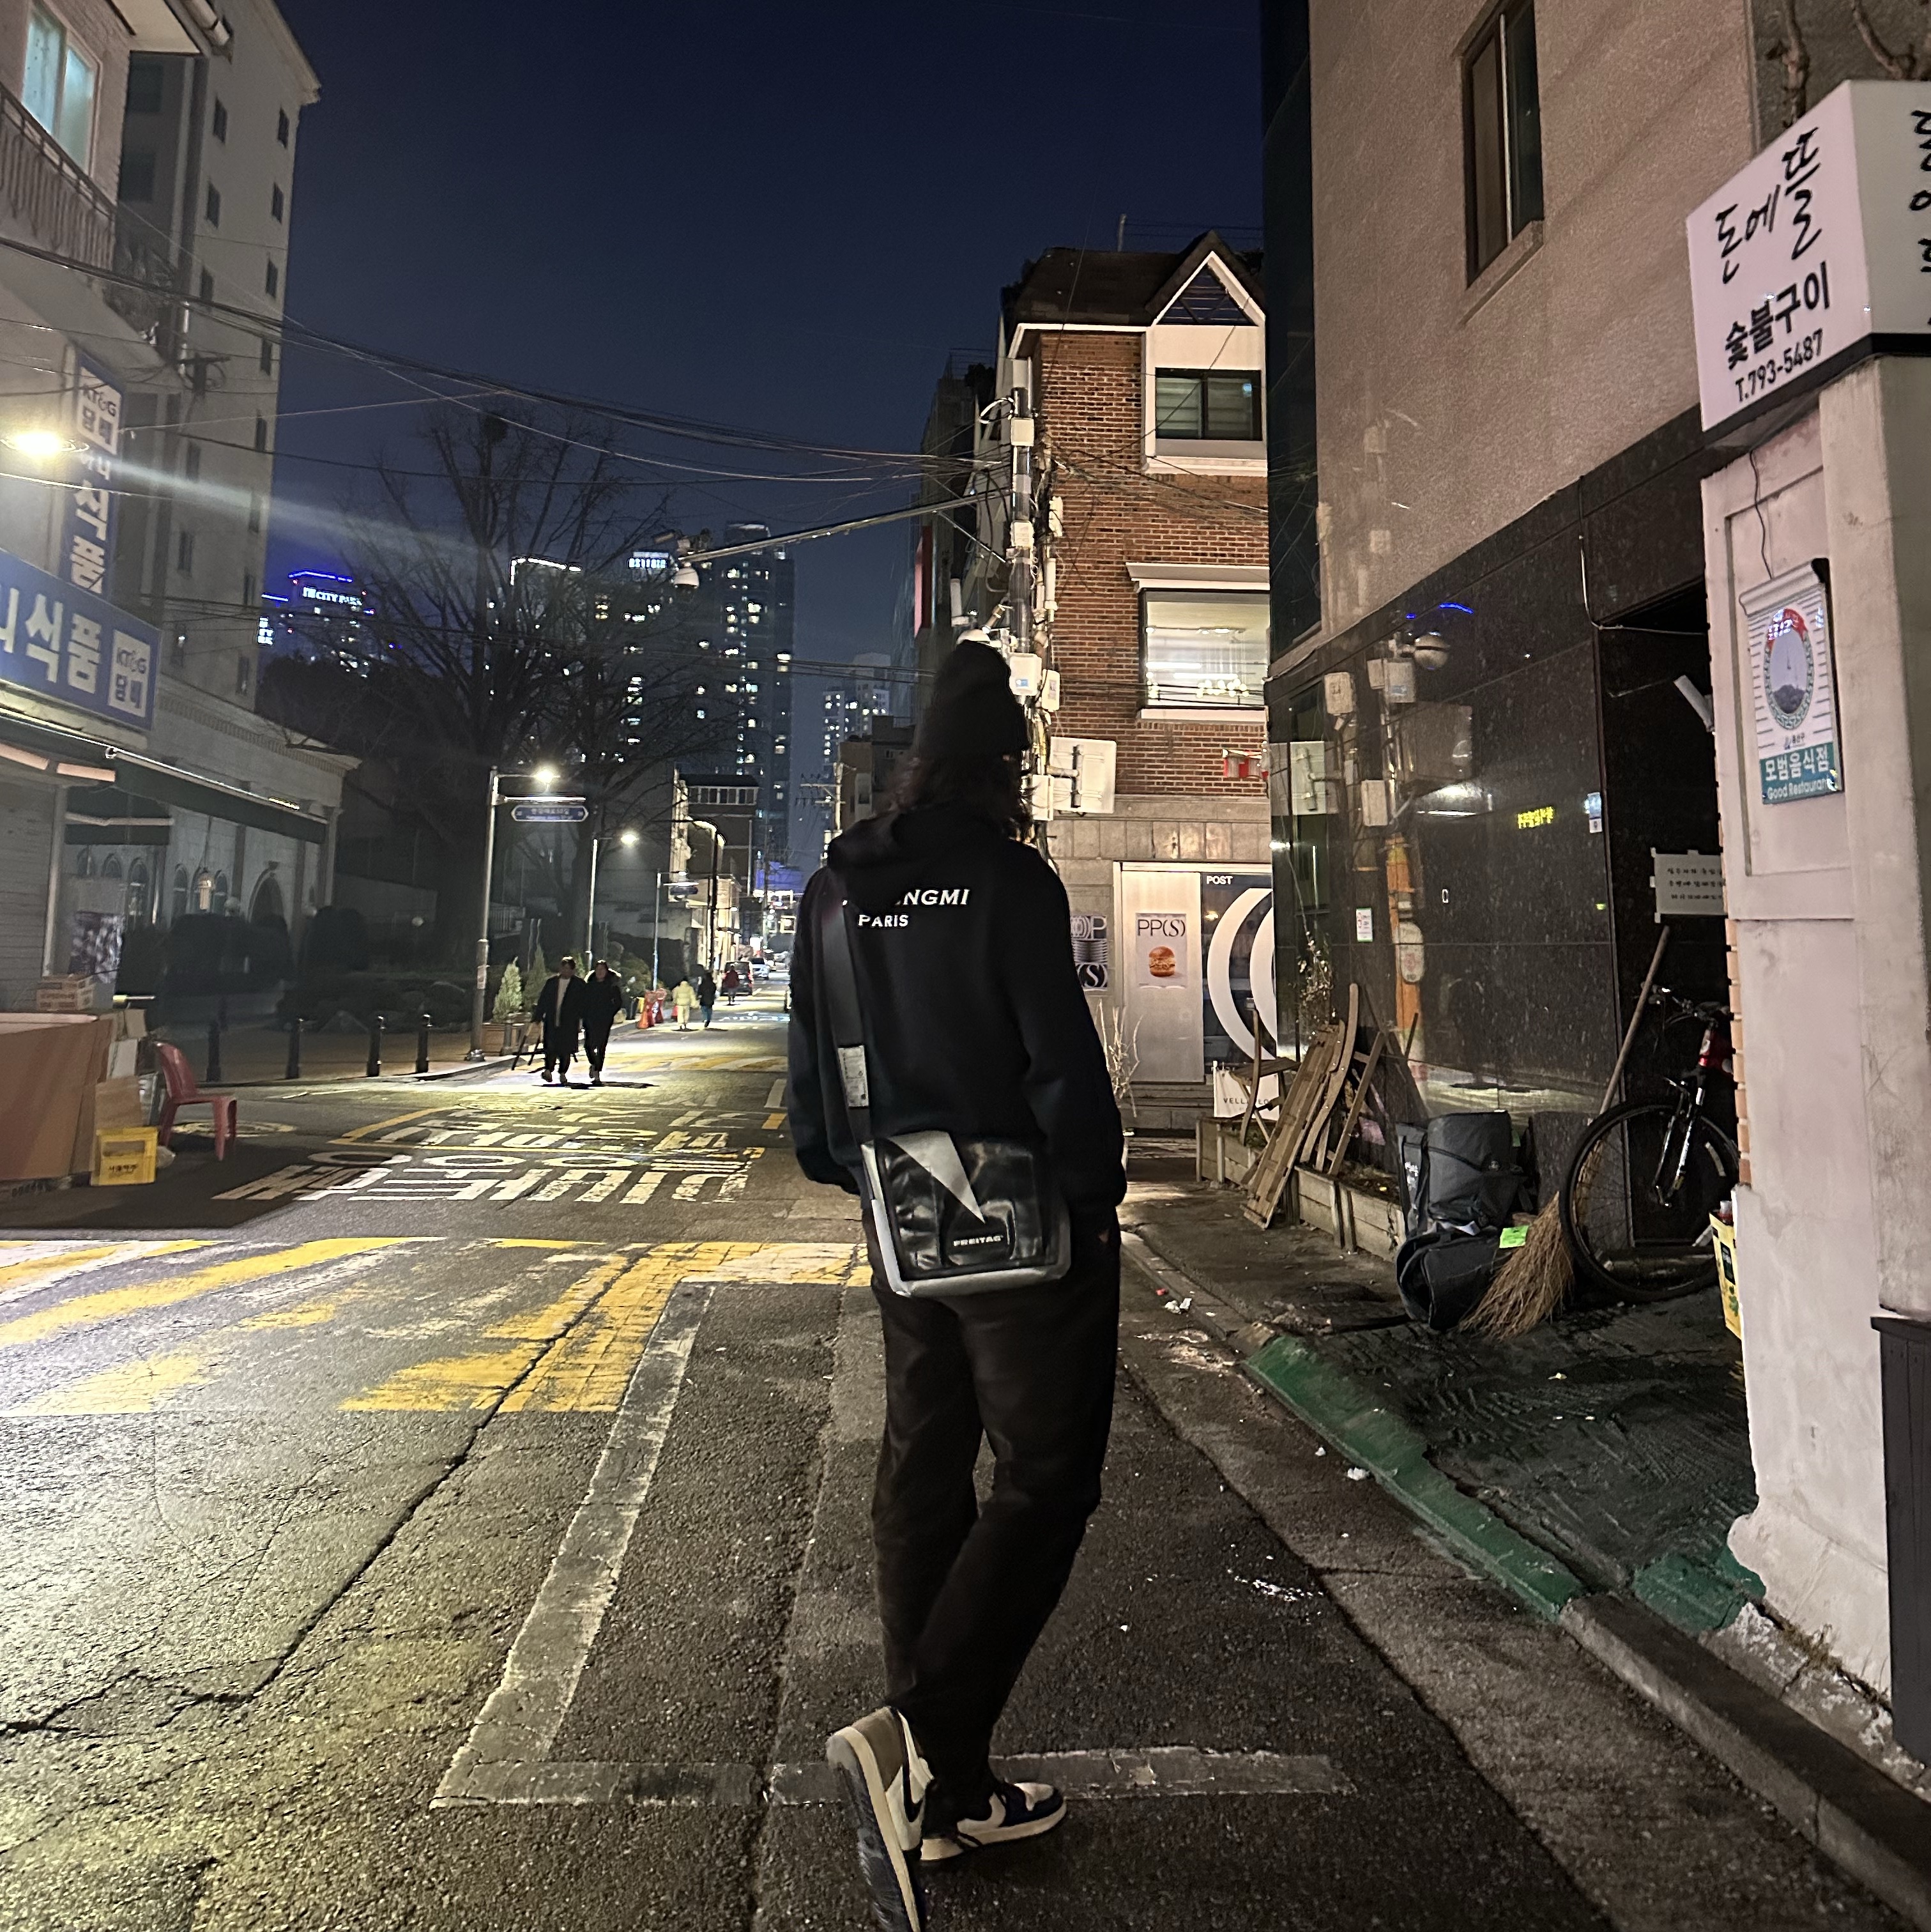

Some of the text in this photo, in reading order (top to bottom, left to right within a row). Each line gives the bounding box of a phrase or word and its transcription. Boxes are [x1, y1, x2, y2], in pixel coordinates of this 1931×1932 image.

[1725, 261, 1830, 370] 숯불구이
[1735, 328, 1823, 403] T.793-5487
[1765, 745, 1829, 781] 모범음식점
[1767, 775, 1831, 800] Good Restauran
[1206, 875, 1233, 885] POST
[895, 889, 970, 905] NGMI
[858, 914, 909, 927] PARIS
